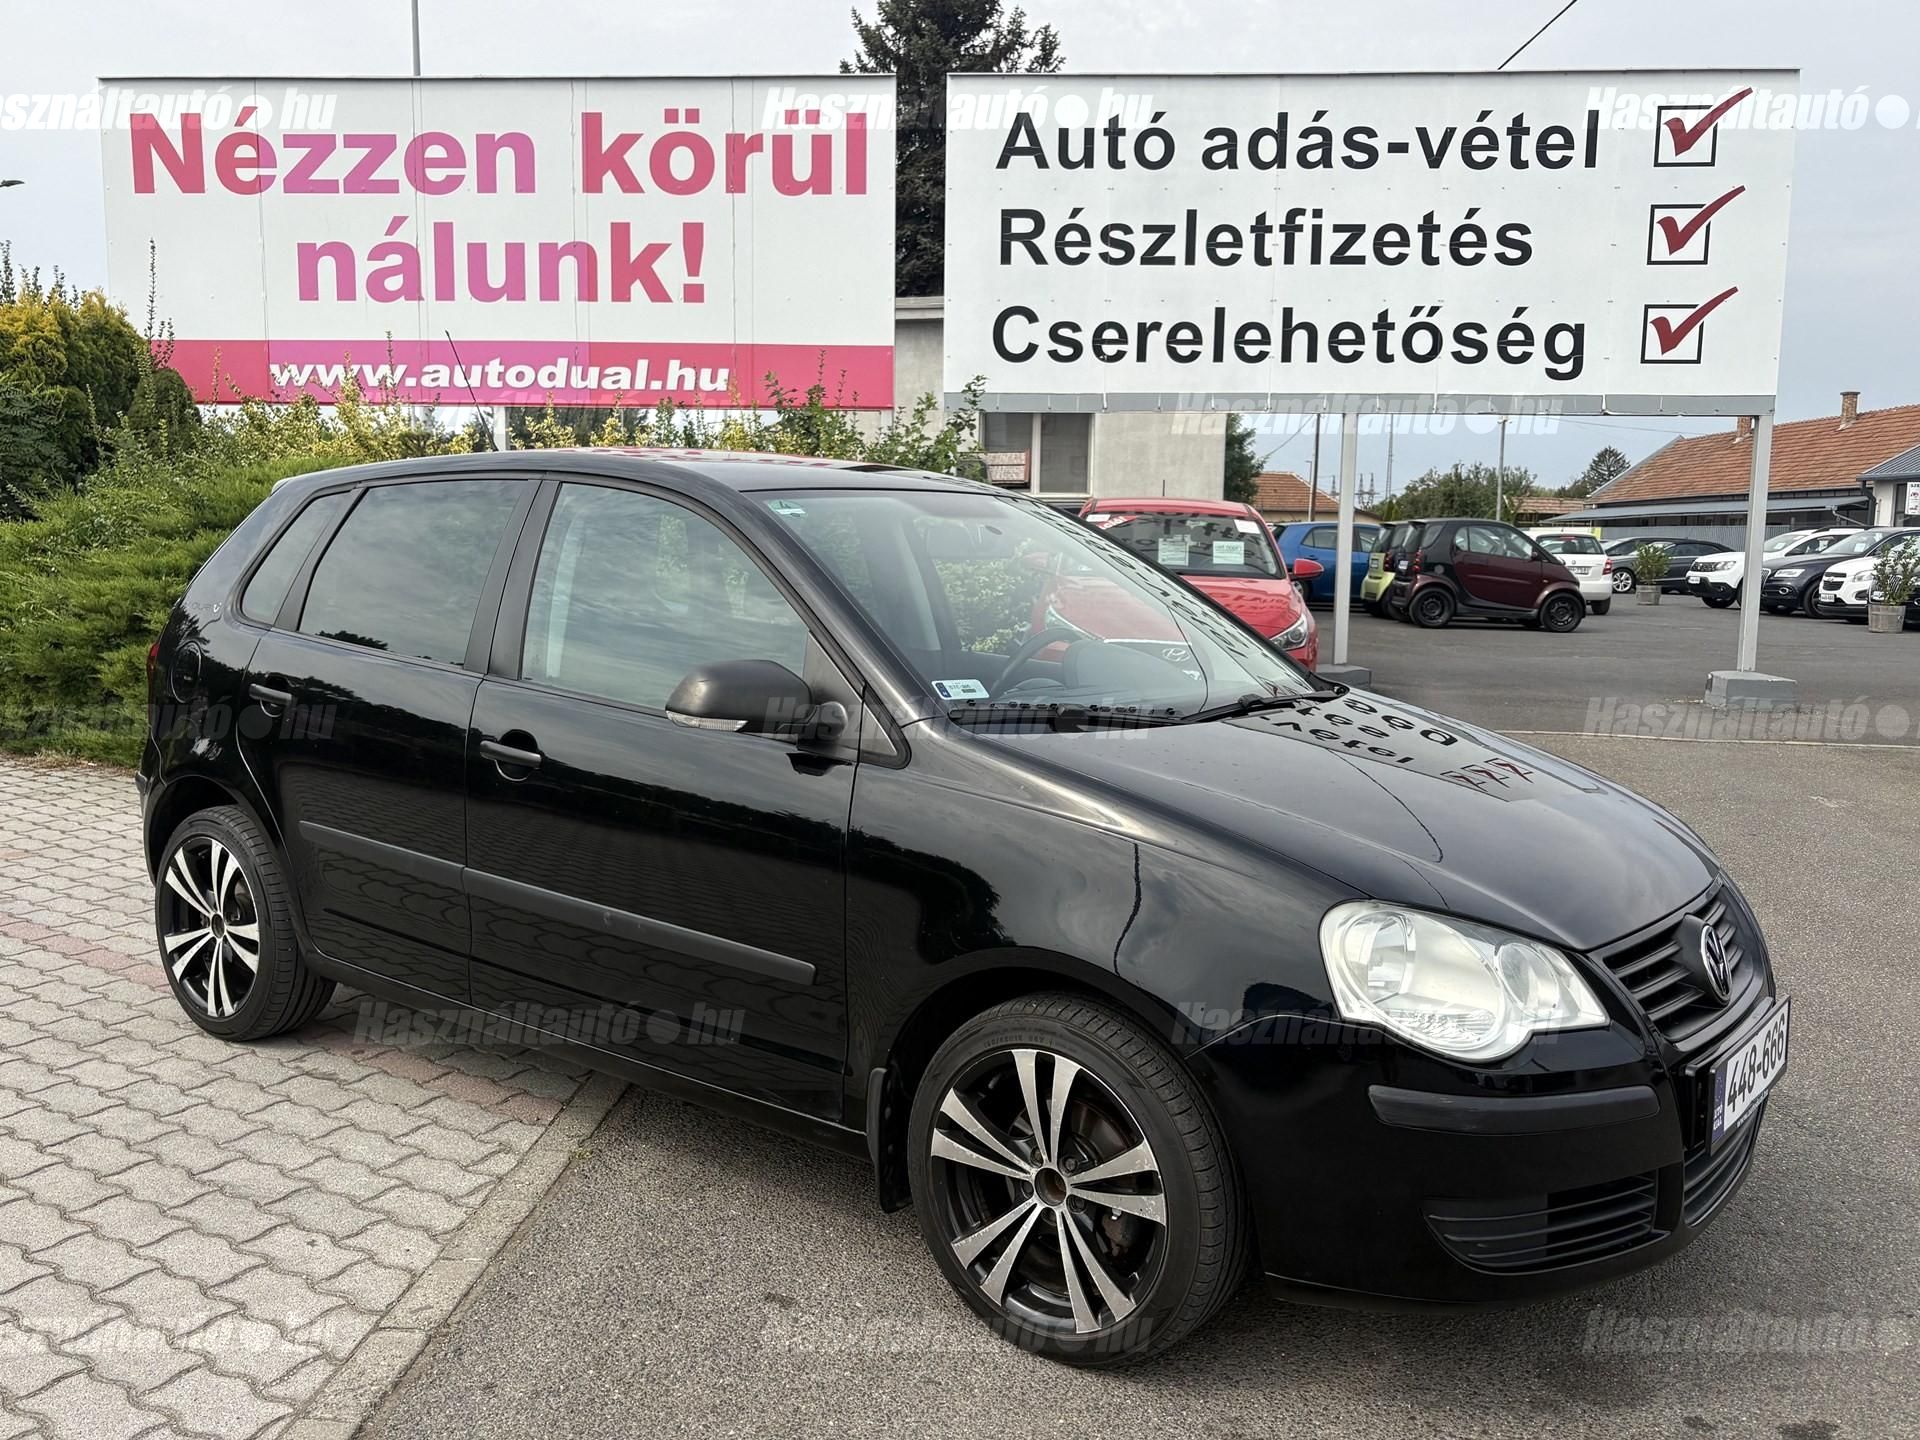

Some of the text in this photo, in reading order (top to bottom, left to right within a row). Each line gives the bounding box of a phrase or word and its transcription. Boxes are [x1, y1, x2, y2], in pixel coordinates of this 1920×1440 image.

[130, 106, 867, 195] Nézzen körül
[995, 109, 1599, 171] Autó adás-vétel
[297, 216, 705, 304] nálunk!
[998, 205, 1533, 267] Részletfizetés
[269, 357, 730, 392] www.autodual.hu
[993, 303, 1586, 380] Cserelehetőség
[1727, 1013, 1785, 1112] 448-666
